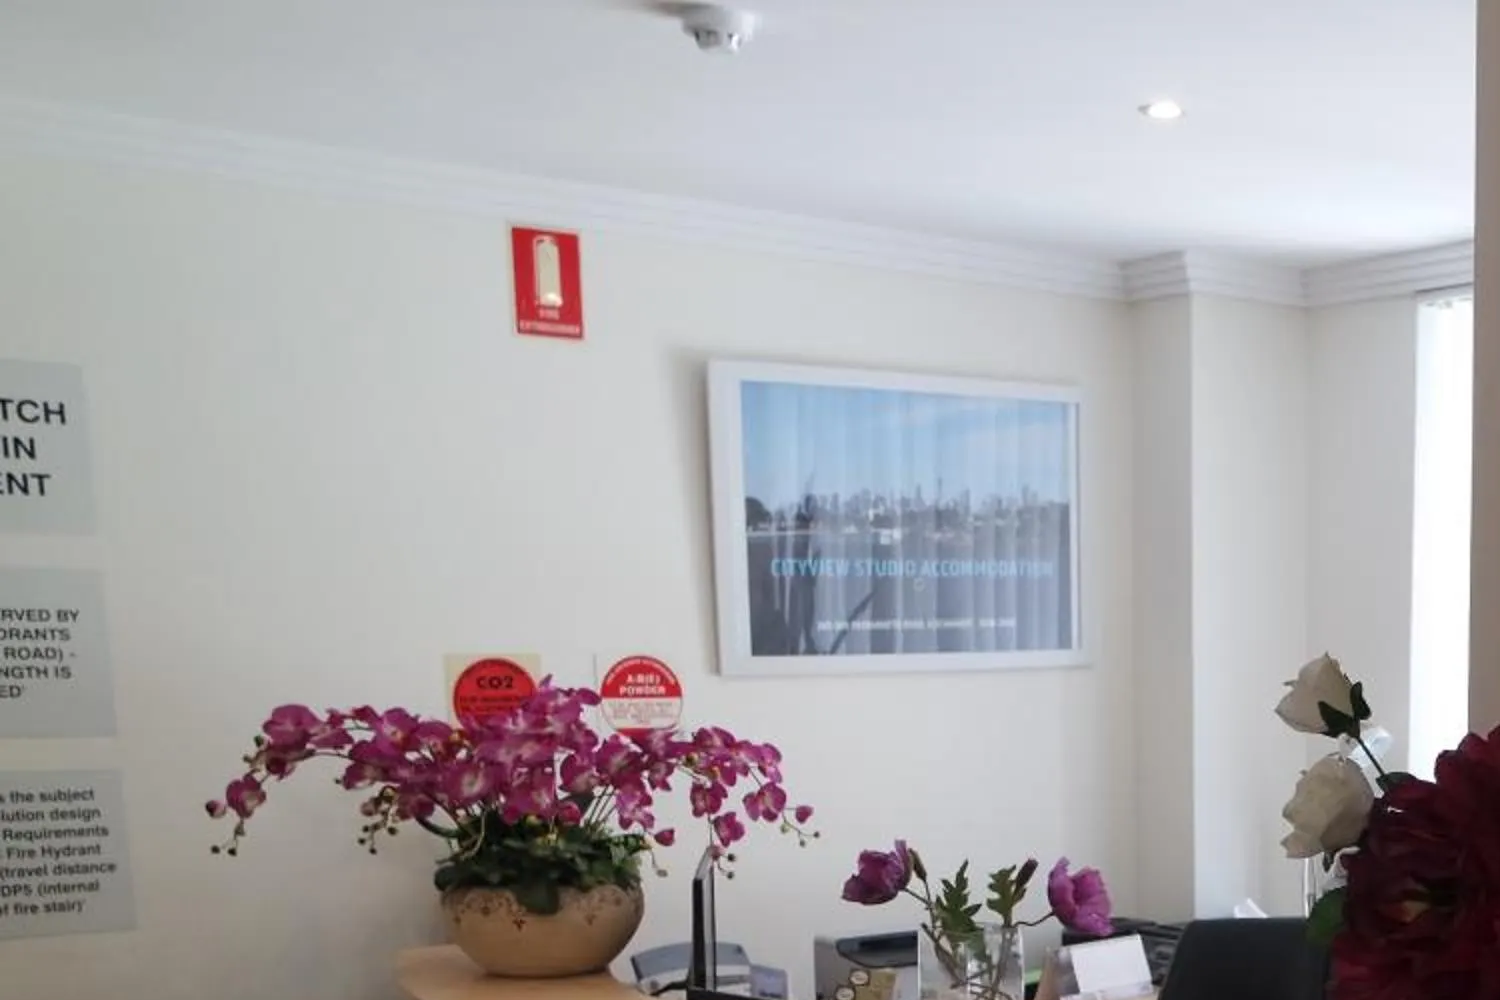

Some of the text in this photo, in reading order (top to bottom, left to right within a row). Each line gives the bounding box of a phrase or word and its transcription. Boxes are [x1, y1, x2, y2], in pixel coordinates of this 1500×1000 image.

[3, 436, 36, 460] IN
[0, 472, 51, 496] NT
[771, 558, 848, 577] CITYVIEW
[853, 558, 916, 577] STUDIO
[57, 608, 80, 623] BY
[476, 675, 513, 689] CO2
[39, 788, 94, 803] subject
[50, 808, 101, 822] design
[41, 845, 101, 860] Hydrant
[53, 862, 116, 877] distance
